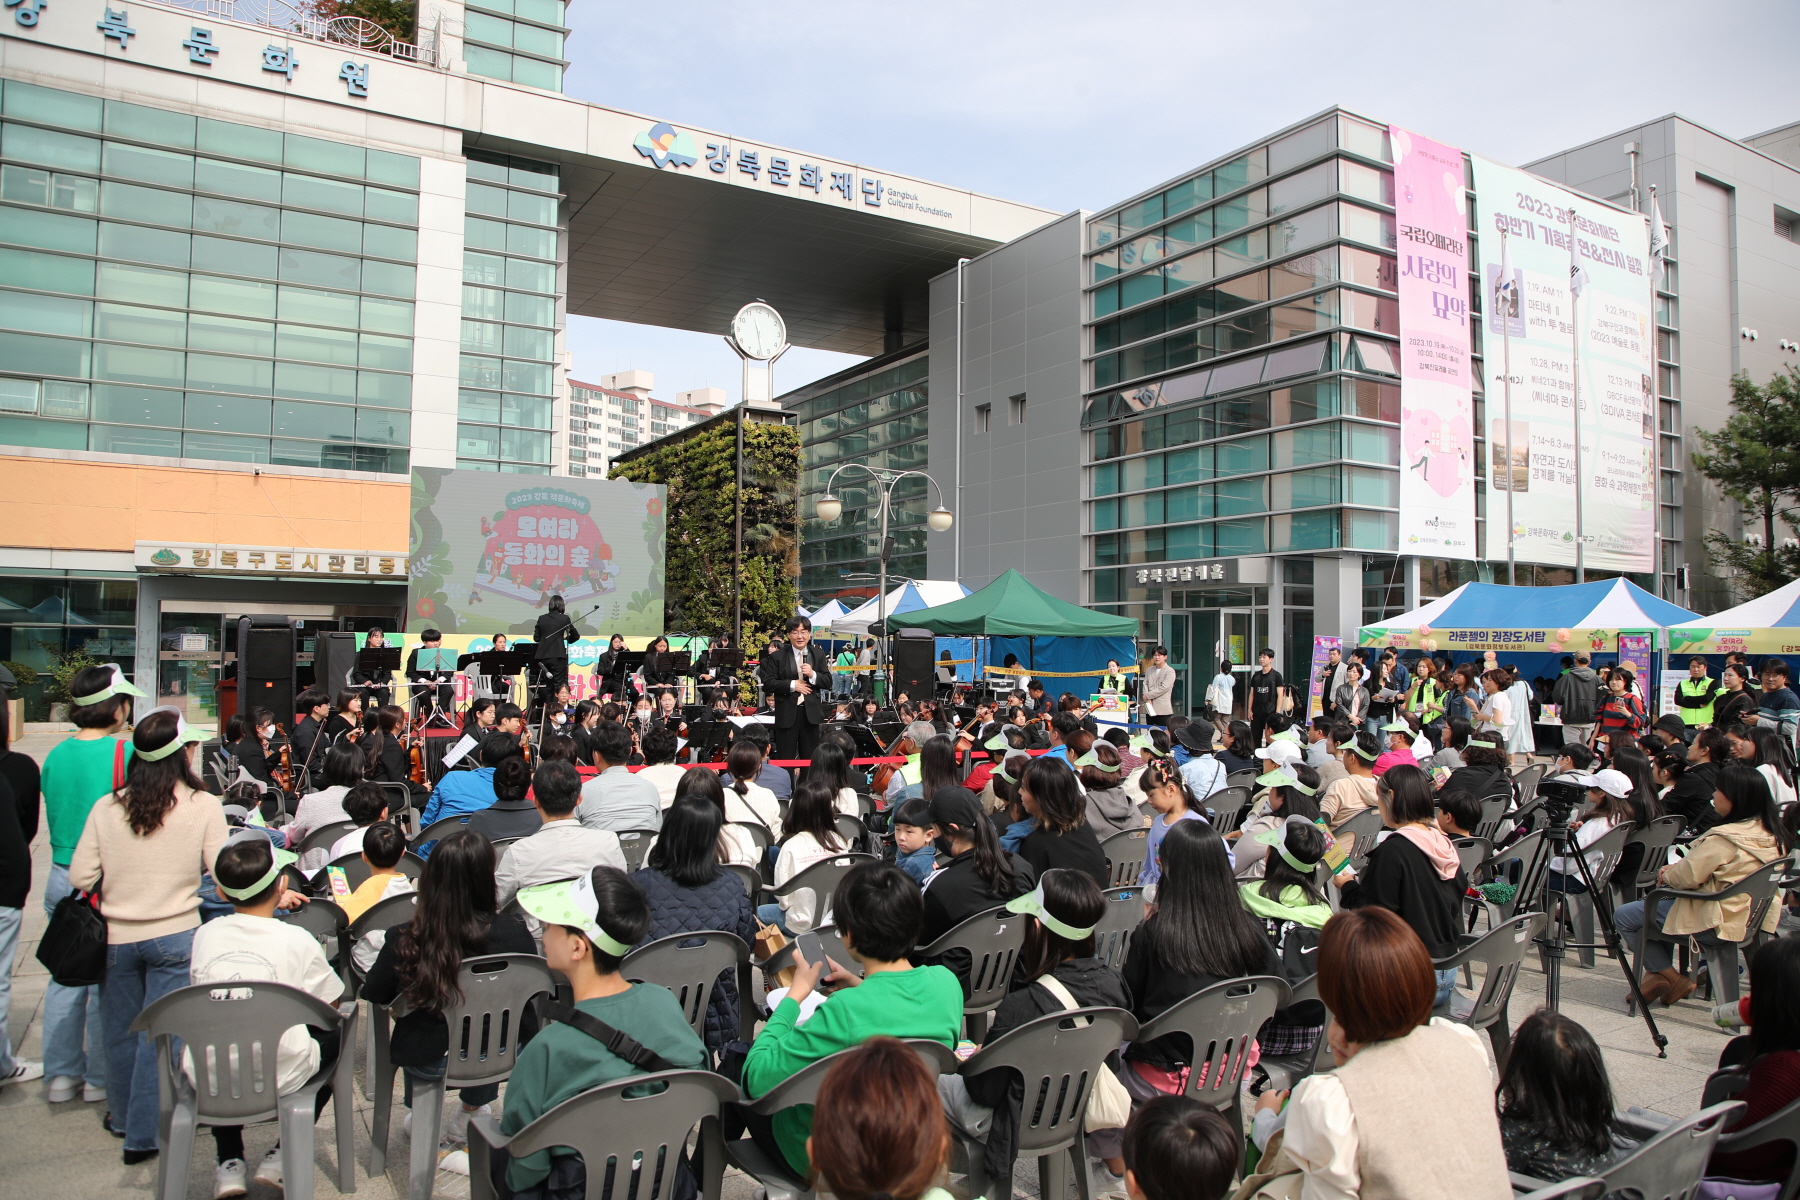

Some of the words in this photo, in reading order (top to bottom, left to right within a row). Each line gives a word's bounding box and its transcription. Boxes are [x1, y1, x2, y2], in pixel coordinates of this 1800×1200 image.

[706, 142, 884, 207] 강북문화재단
[888, 188, 919, 202] Gangbuk
[888, 198, 914, 210] Cultural
[915, 202, 952, 218] Foundation
[1516, 192, 1553, 220] 2023
[1554, 206, 1620, 243] 강북문화재단
[1400, 224, 1464, 257] 국립오페라단
[1494, 212, 1535, 240] 하반기
[1626, 254, 1642, 276] 일정
[1402, 255, 1457, 289] 사랑의
[1542, 286, 1555, 296] AM
[1432, 290, 1466, 326] 묘약
[1528, 299, 1552, 314] 마티네
[1528, 316, 1546, 328] with
[1552, 361, 1562, 371] PM
[1564, 364, 1569, 373] 3
[1532, 435, 1562, 448] 7.14~8.3
[1532, 454, 1556, 468] 자연과
[1532, 468, 1555, 482] 경계를
[1594, 476, 1608, 488] 명화
[1609, 479, 1616, 490] 속
[512, 494, 533, 505] 2023
[534, 492, 548, 501] 강북
[550, 492, 586, 509] 책문화축제
[517, 516, 579, 540] 모여라
[1526, 527, 1558, 540] 강북문화재단
[192, 548, 408, 575] 강북구도시관리공
[503, 542, 564, 567] 동화의
[570, 545, 590, 568] 숲
[1136, 564, 1224, 584] 강북진달래홀
[1448, 630, 1489, 642] 라푼젤의
[1492, 631, 1546, 642] 권장도서탑
